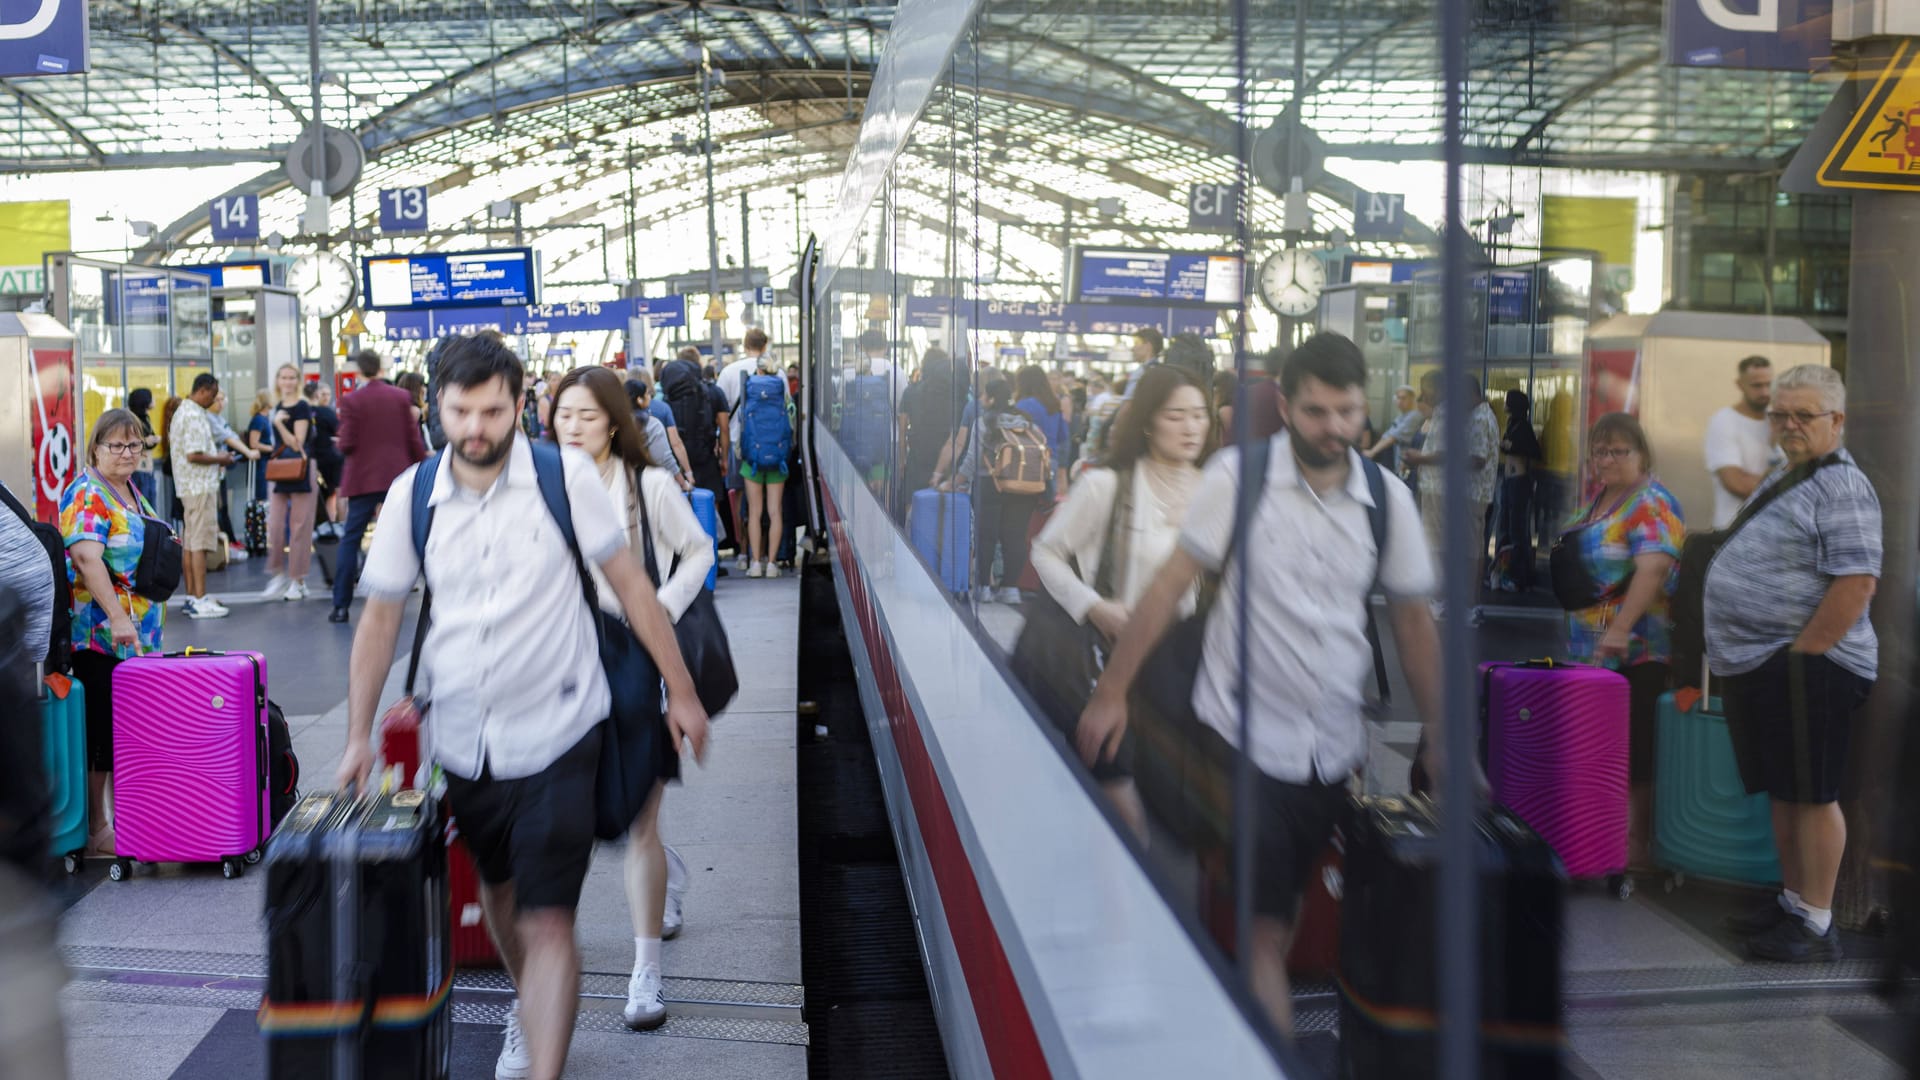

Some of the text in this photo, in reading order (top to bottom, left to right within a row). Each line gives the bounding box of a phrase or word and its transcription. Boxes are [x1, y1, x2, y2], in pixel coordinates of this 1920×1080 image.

[213, 196, 249, 229] 14
[388, 188, 424, 221] 13
[761, 287, 772, 304] E
[525, 303, 553, 318] 1-12
[565, 301, 601, 316] 15-16
